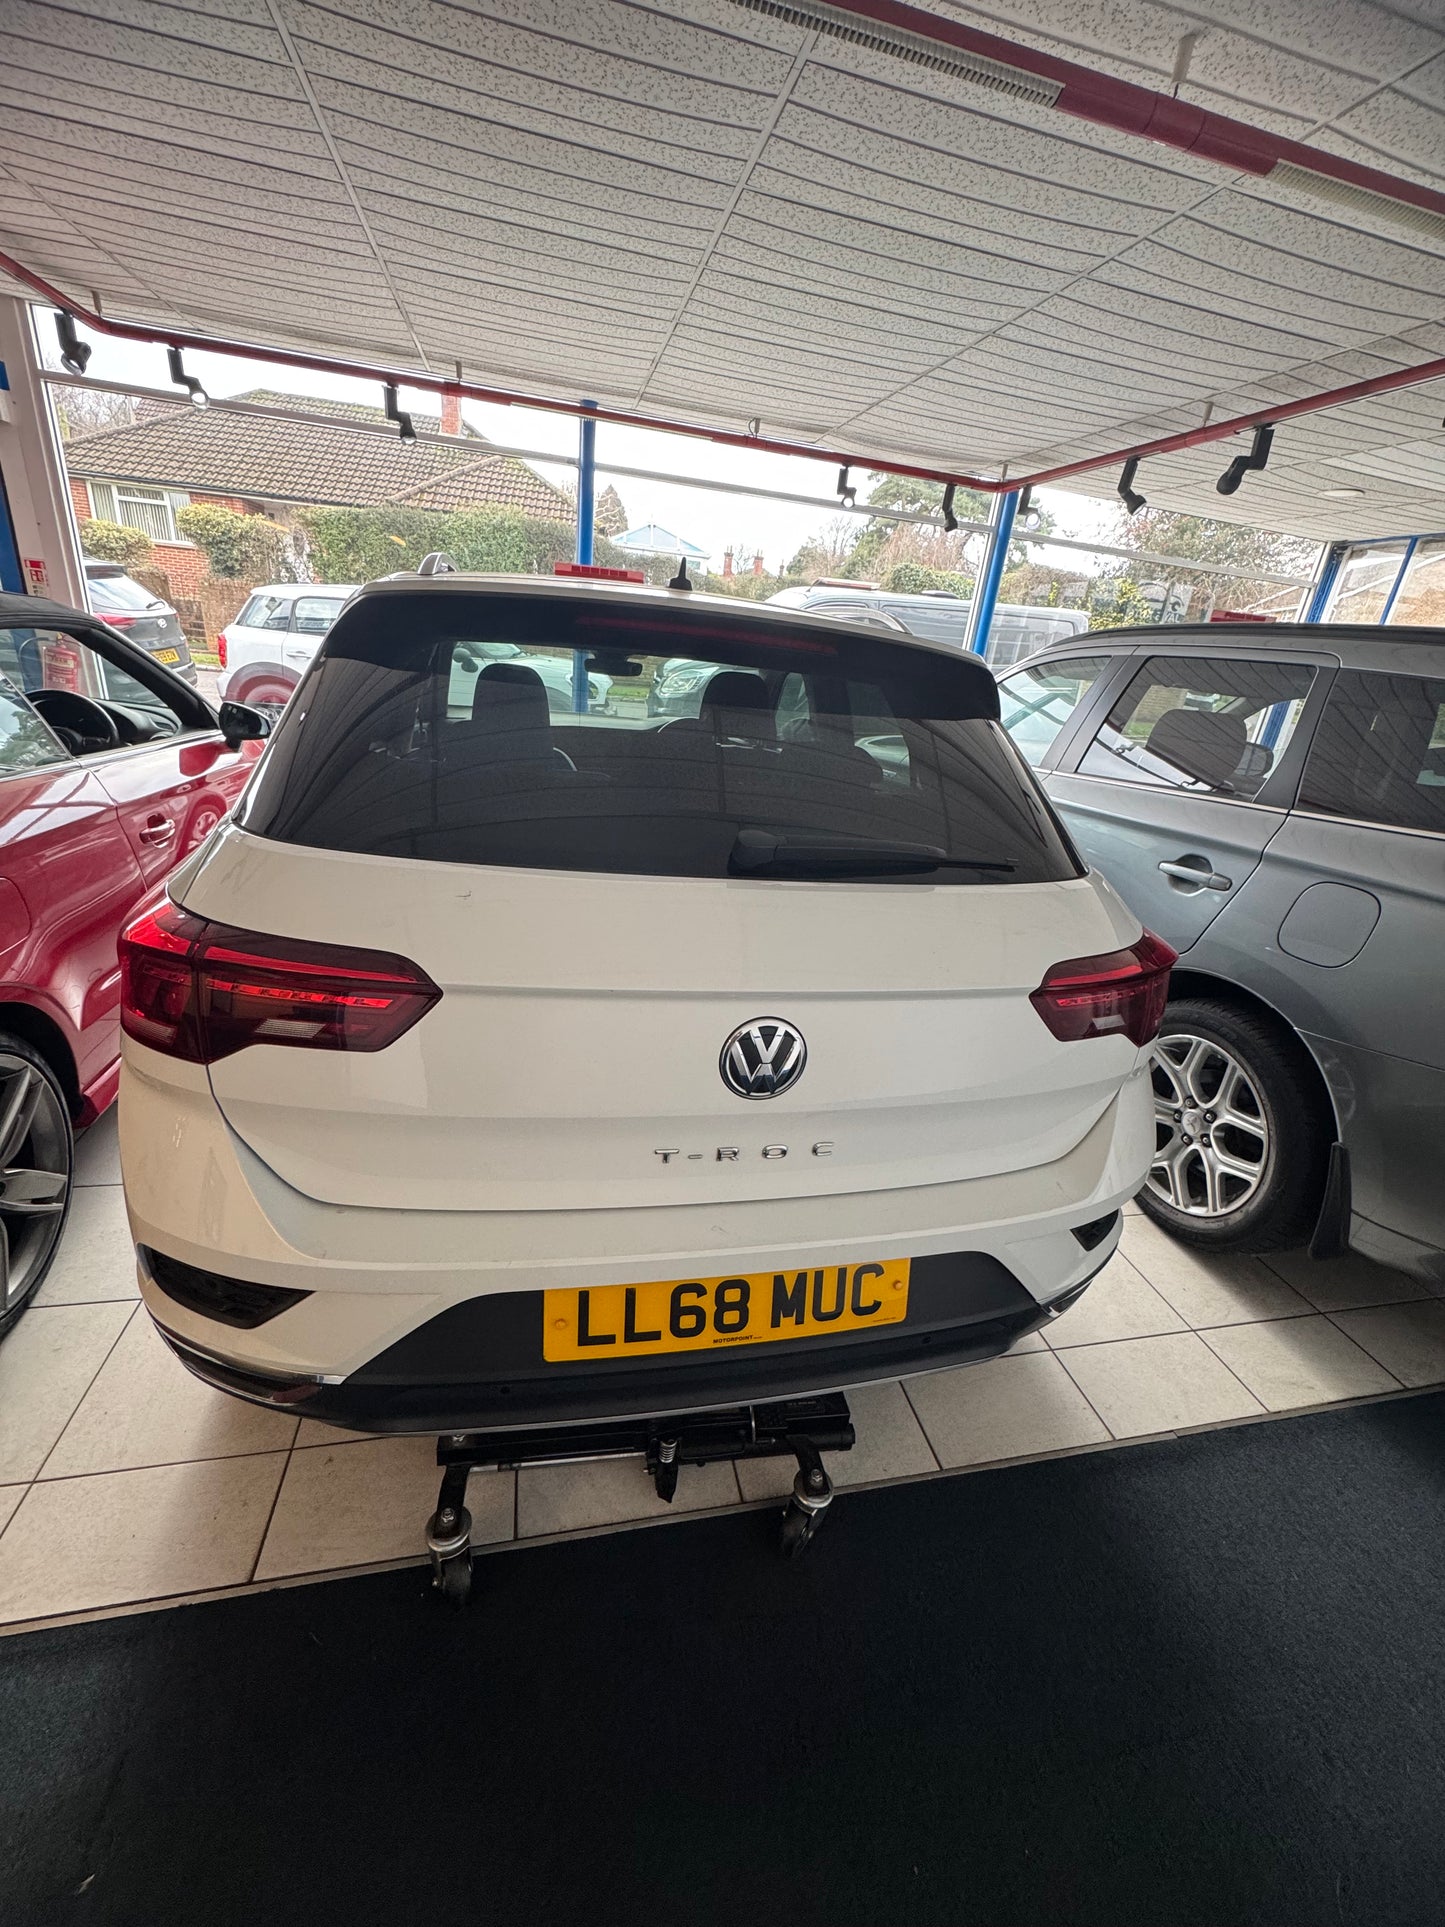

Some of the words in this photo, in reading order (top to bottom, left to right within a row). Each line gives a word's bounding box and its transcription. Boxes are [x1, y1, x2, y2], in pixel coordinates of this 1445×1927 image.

[654, 1141, 835, 1164] T-ROC
[577, 1278, 751, 1347] LL68
[770, 1263, 885, 1328] MUC
[712, 1334, 753, 1344] MOTORPOINT
